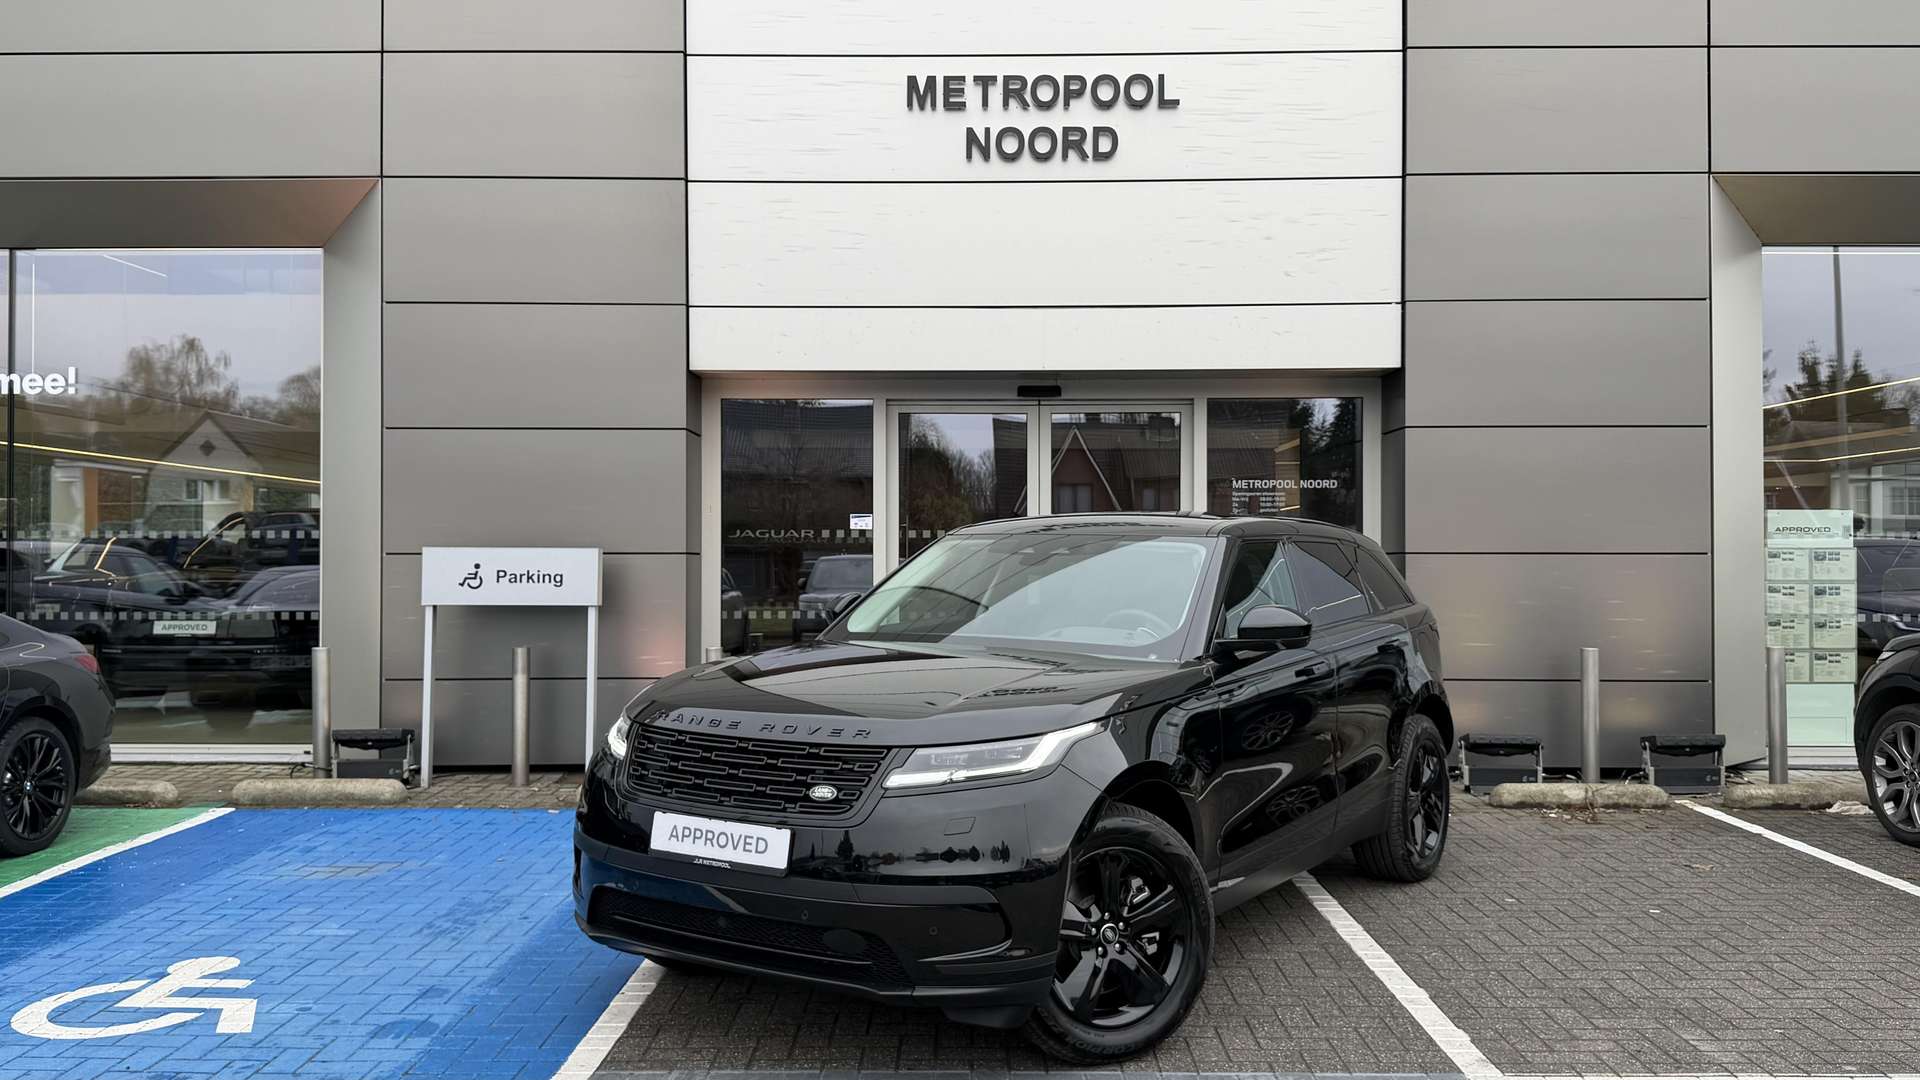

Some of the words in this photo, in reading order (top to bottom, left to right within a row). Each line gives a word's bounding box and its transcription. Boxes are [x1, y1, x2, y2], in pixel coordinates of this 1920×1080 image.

[907, 75, 1180, 111] METROPOOL
[966, 127, 1119, 163] NOORD
[1232, 479, 1298, 489] METROPOOL
[1299, 479, 1338, 489] NOORD
[728, 529, 815, 538] JAGUAR
[496, 569, 564, 588] Parking
[161, 623, 208, 633] APPROVED
[655, 709, 741, 731] RANGE
[759, 723, 874, 740] ROVER
[667, 825, 768, 855] APPROVED
